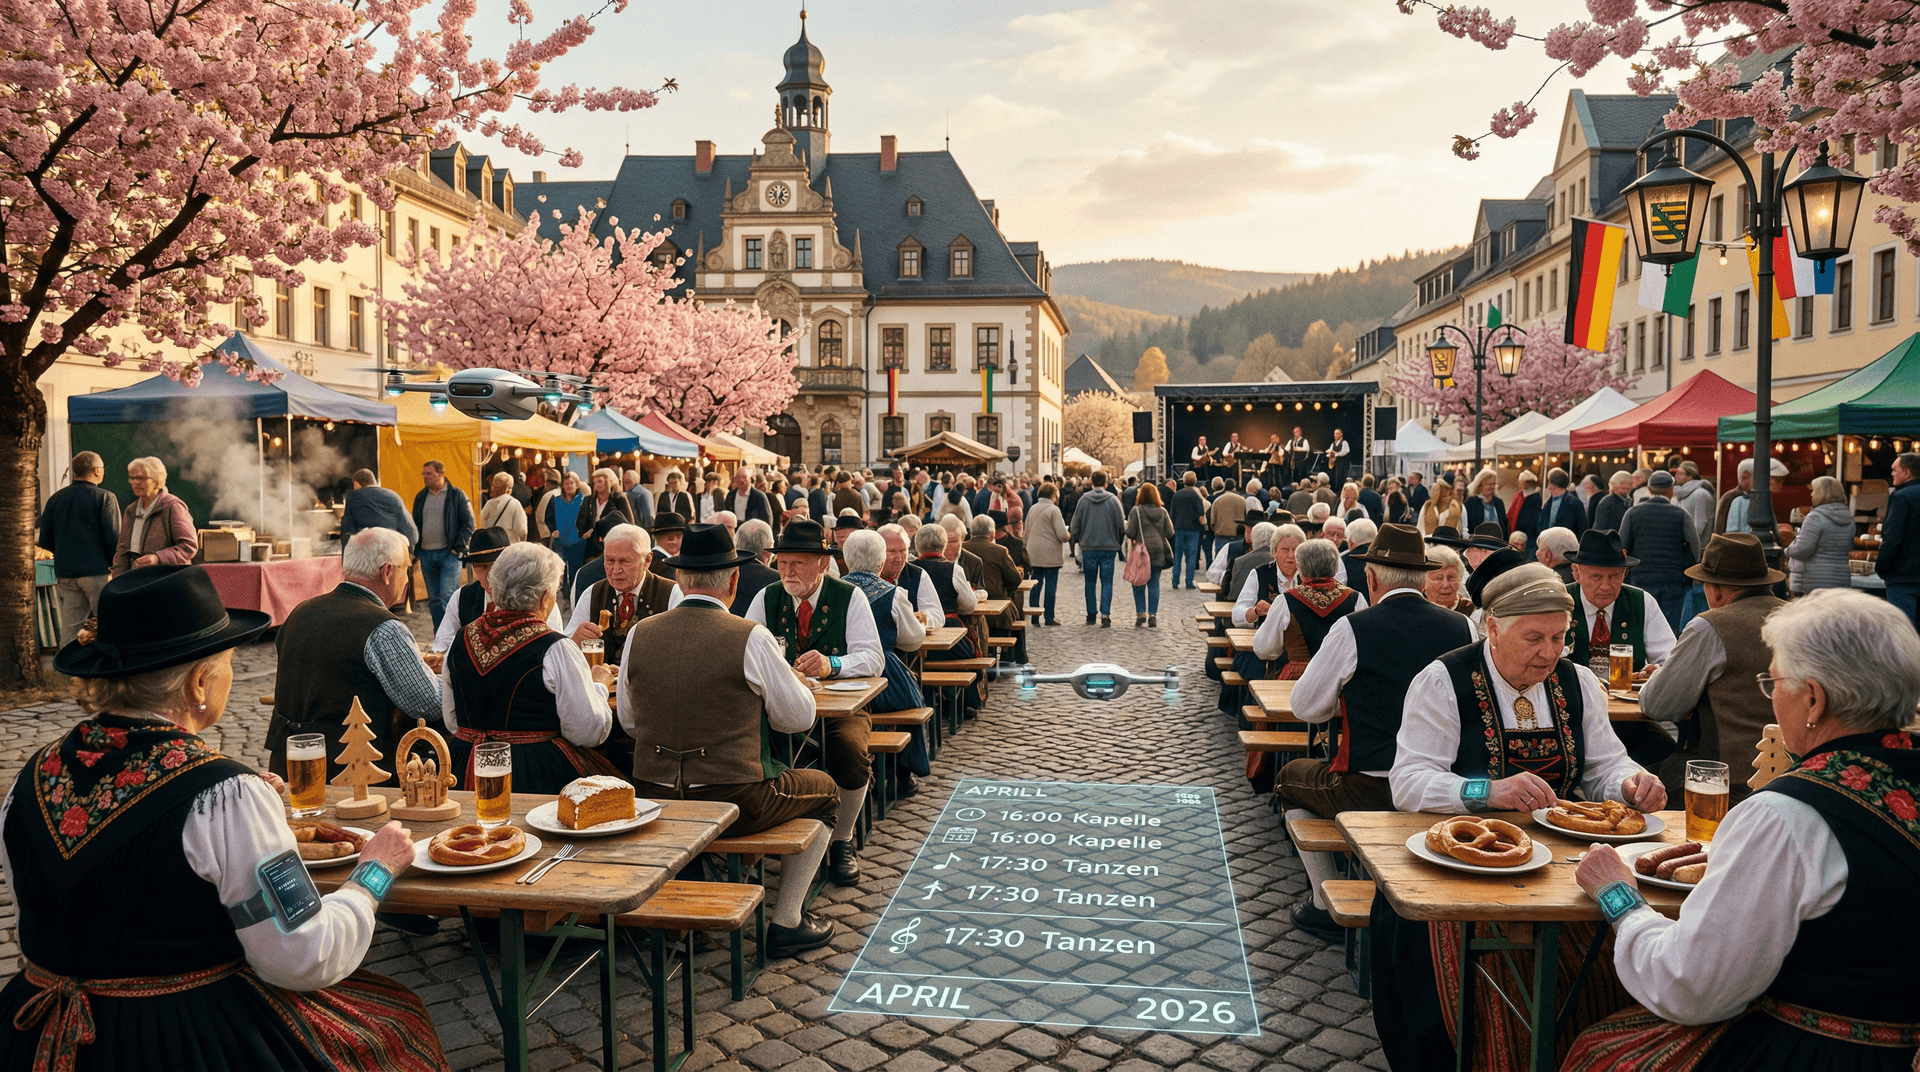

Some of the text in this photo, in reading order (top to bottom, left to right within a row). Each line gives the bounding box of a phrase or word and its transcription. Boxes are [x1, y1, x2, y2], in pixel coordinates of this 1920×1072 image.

[964, 785, 1048, 798] APRILL
[1000, 810, 1162, 828] 16:00 Kapelle
[990, 831, 1163, 851] 16:00 Kapelle
[979, 855, 1160, 877] 17:30 Tanzen
[965, 884, 1156, 908] 17:30 Tanzen
[943, 927, 1156, 955] 17:30 Tanzen
[855, 982, 1236, 1025] APRIL 2026
